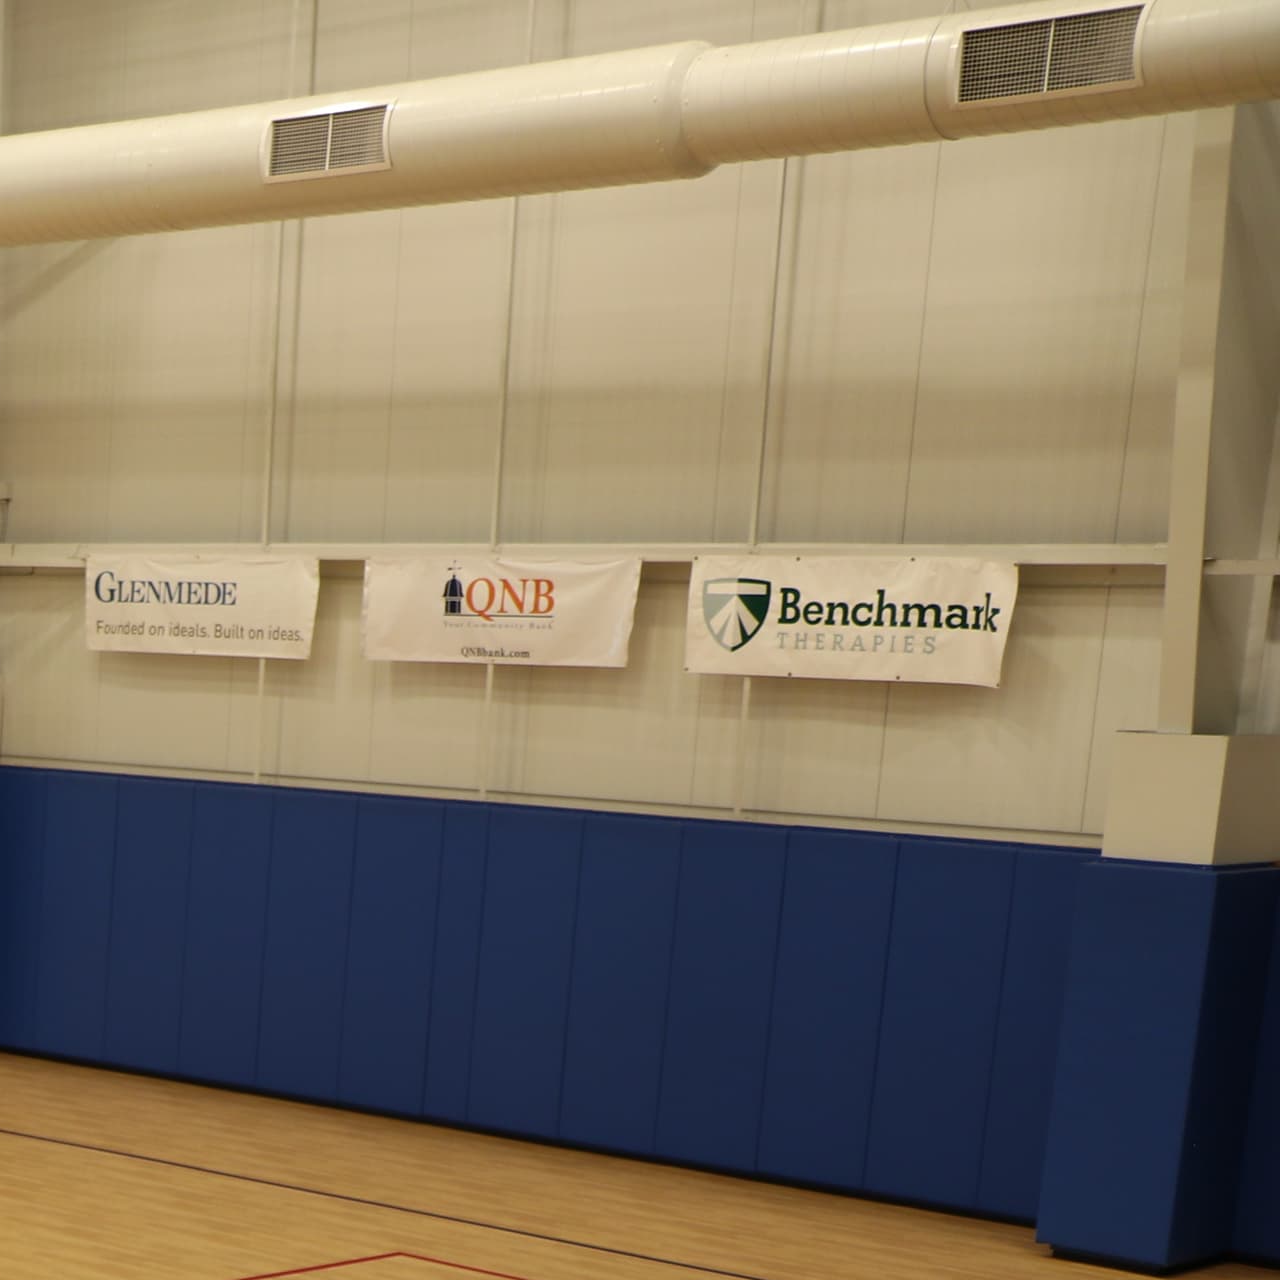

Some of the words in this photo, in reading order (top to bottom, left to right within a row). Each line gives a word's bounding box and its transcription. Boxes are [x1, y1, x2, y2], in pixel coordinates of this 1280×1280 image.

[94, 571, 237, 606] GLENMEDE
[466, 577, 555, 621] QNB
[777, 587, 1001, 633] Benchmark
[96, 620, 145, 636] Founded
[148, 624, 165, 636] on
[169, 622, 210, 638] ideals.
[214, 623, 244, 640] Built
[248, 627, 265, 640] on
[268, 626, 304, 642] ideas.
[777, 631, 937, 655] THERAPIES
